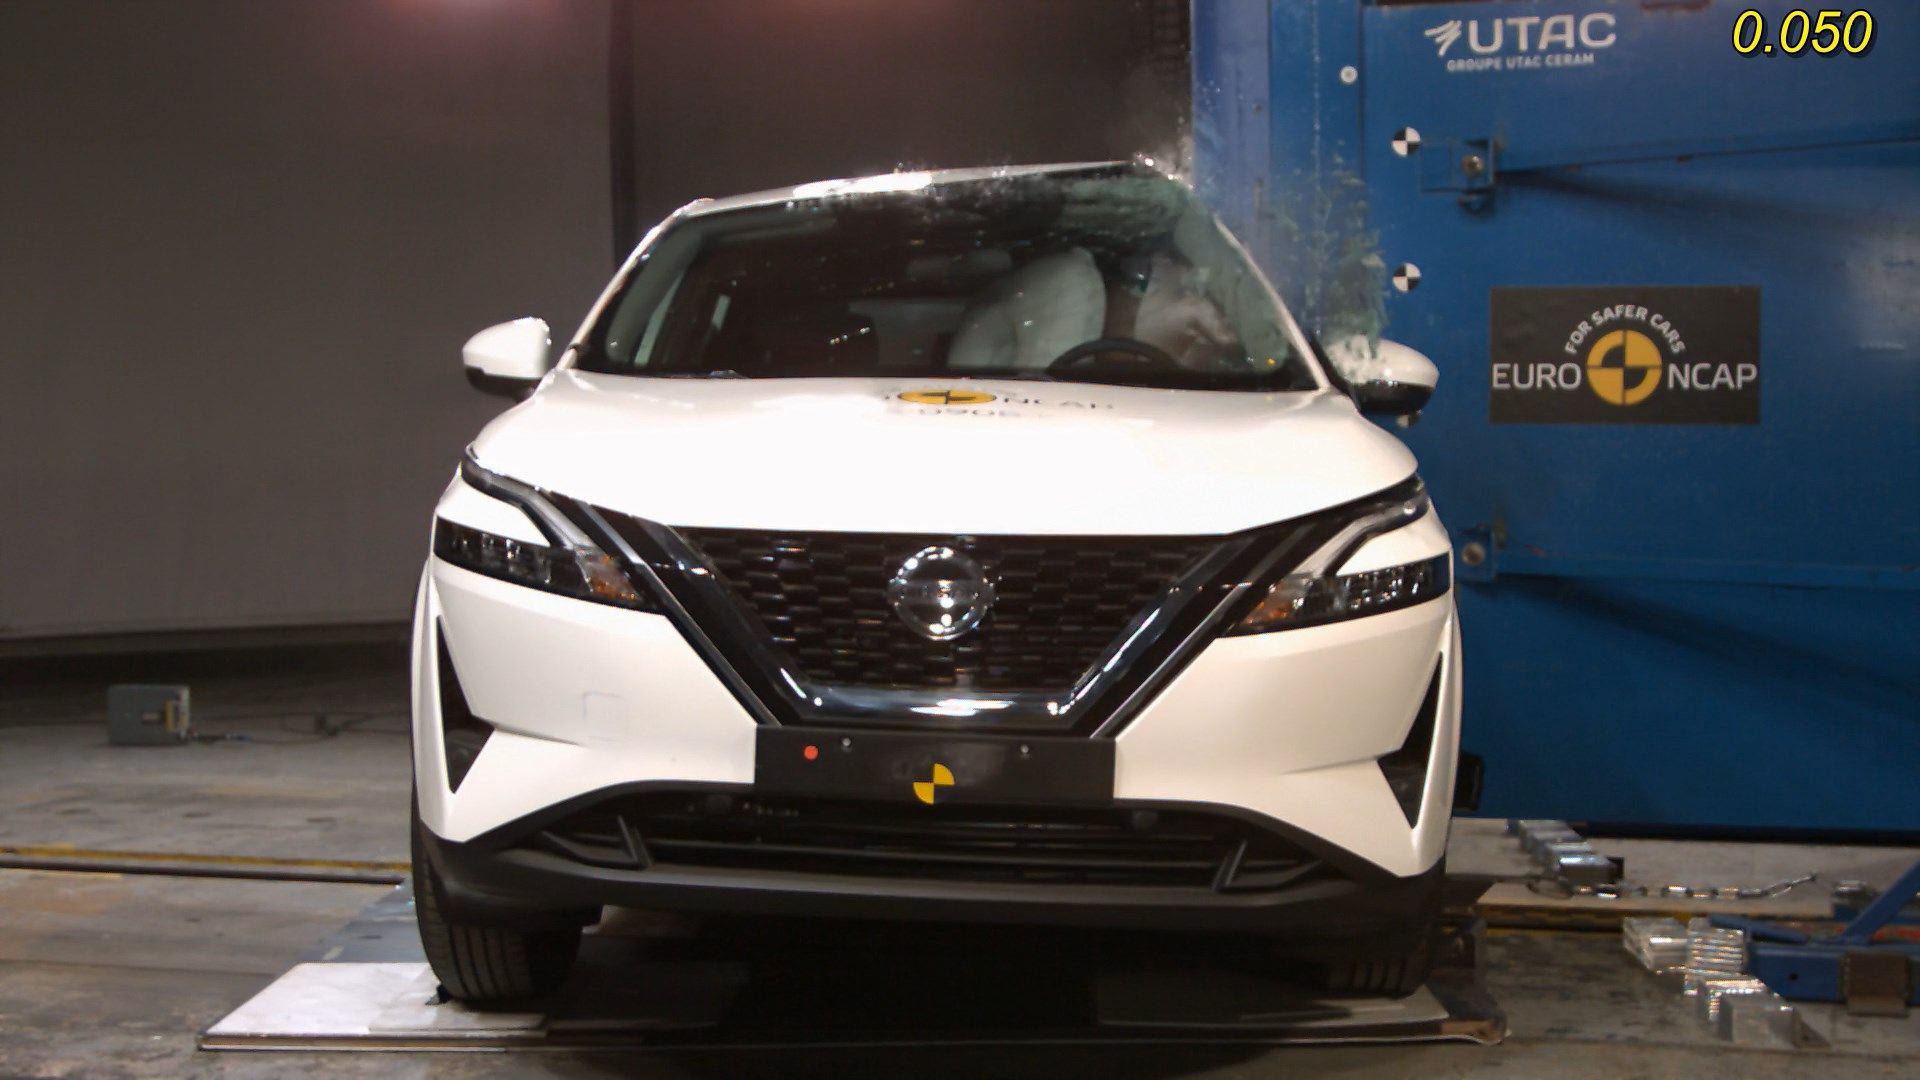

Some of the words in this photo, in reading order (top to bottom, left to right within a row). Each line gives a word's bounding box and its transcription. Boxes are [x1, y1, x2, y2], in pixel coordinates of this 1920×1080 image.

[1468, 13, 1616, 54] UTAC
[1446, 56, 1503, 71] GROUPE
[1506, 54, 1540, 69] UTAC
[1545, 53, 1595, 67] CERAM
[1564, 319, 1593, 355] FOR
[1590, 304, 1649, 326] SAFER
[1649, 313, 1687, 354] CARS
[1491, 362, 1582, 390] EURO
[1667, 362, 1758, 390] NCAP
